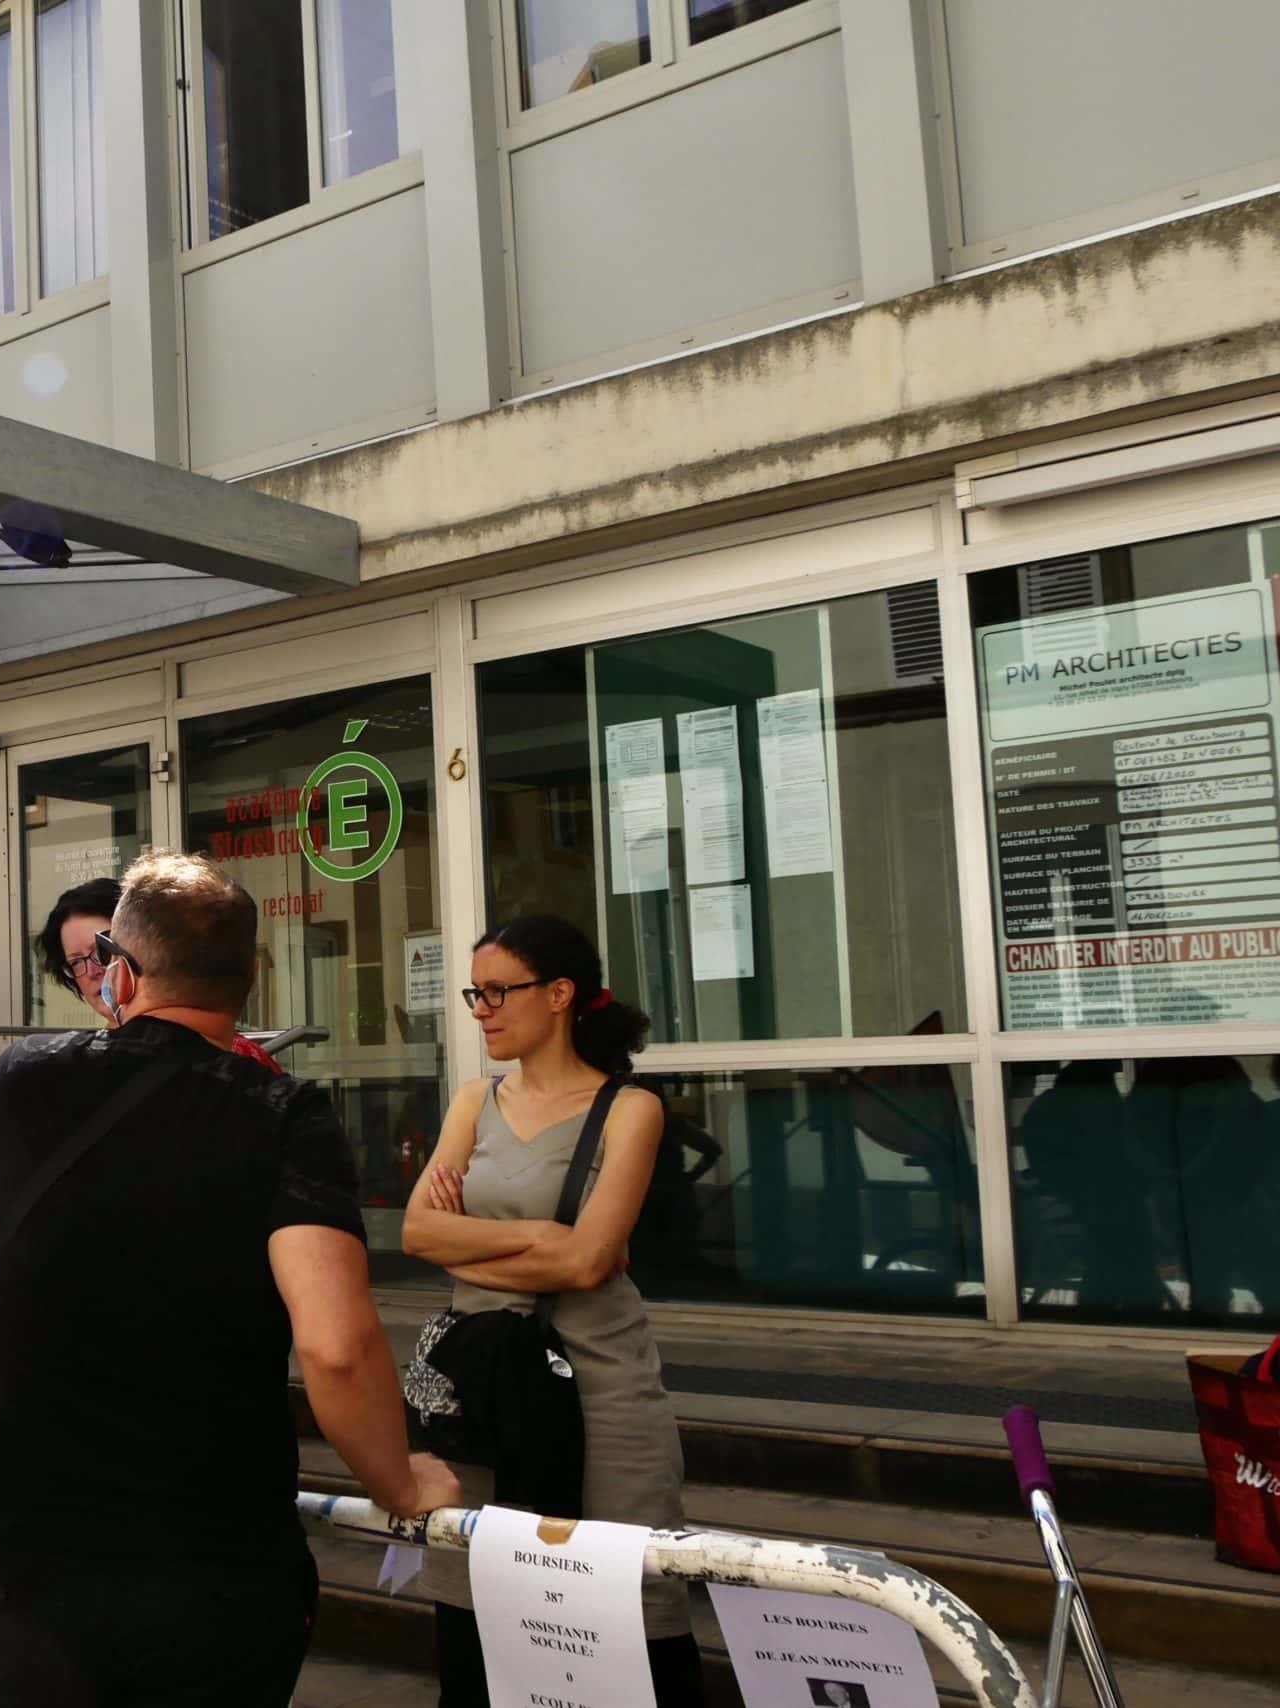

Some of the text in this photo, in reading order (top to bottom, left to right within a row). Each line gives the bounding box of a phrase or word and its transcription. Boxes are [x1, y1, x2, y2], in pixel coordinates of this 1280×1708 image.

[1005, 631, 1242, 686] PM ARCHITECTES
[448, 748, 466, 781] 6
[997, 789, 1020, 798] DATE
[224, 783, 321, 824] académie
[998, 797, 1101, 815] NATURE DES TRAVAUX
[1000, 823, 1091, 839] AUTEUR DU PROJET
[1000, 833, 1078, 848] ARCHITECTURAL
[1002, 848, 1102, 864] SURFACE DU TERRAIN
[1003, 864, 1113, 880] SURFACE DU PLANCHER
[1004, 880, 1124, 897] HAUTEUR CONSTRUCTION
[263, 889, 325, 918] rectorat
[1005, 903, 1045, 912] DOSSIER
[1047, 901, 1060, 909] EN
[1006, 918, 1028, 926] DATE
[1007, 941, 1096, 972] CHANTIER
[1100, 932, 1185, 965] INTERDIT
[1189, 931, 1214, 960] AU
[513, 1549, 594, 1577] BOURSIERS:
[544, 1589, 564, 1605] 387
[520, 1618, 600, 1643] ASSISTANTE
[762, 1613, 870, 1634] LES BOURSES
[529, 1633, 595, 1658] SOCIALE:
[754, 1650, 905, 1676] DE JEAN MONNET!!
[565, 1671, 574, 1683] 0
